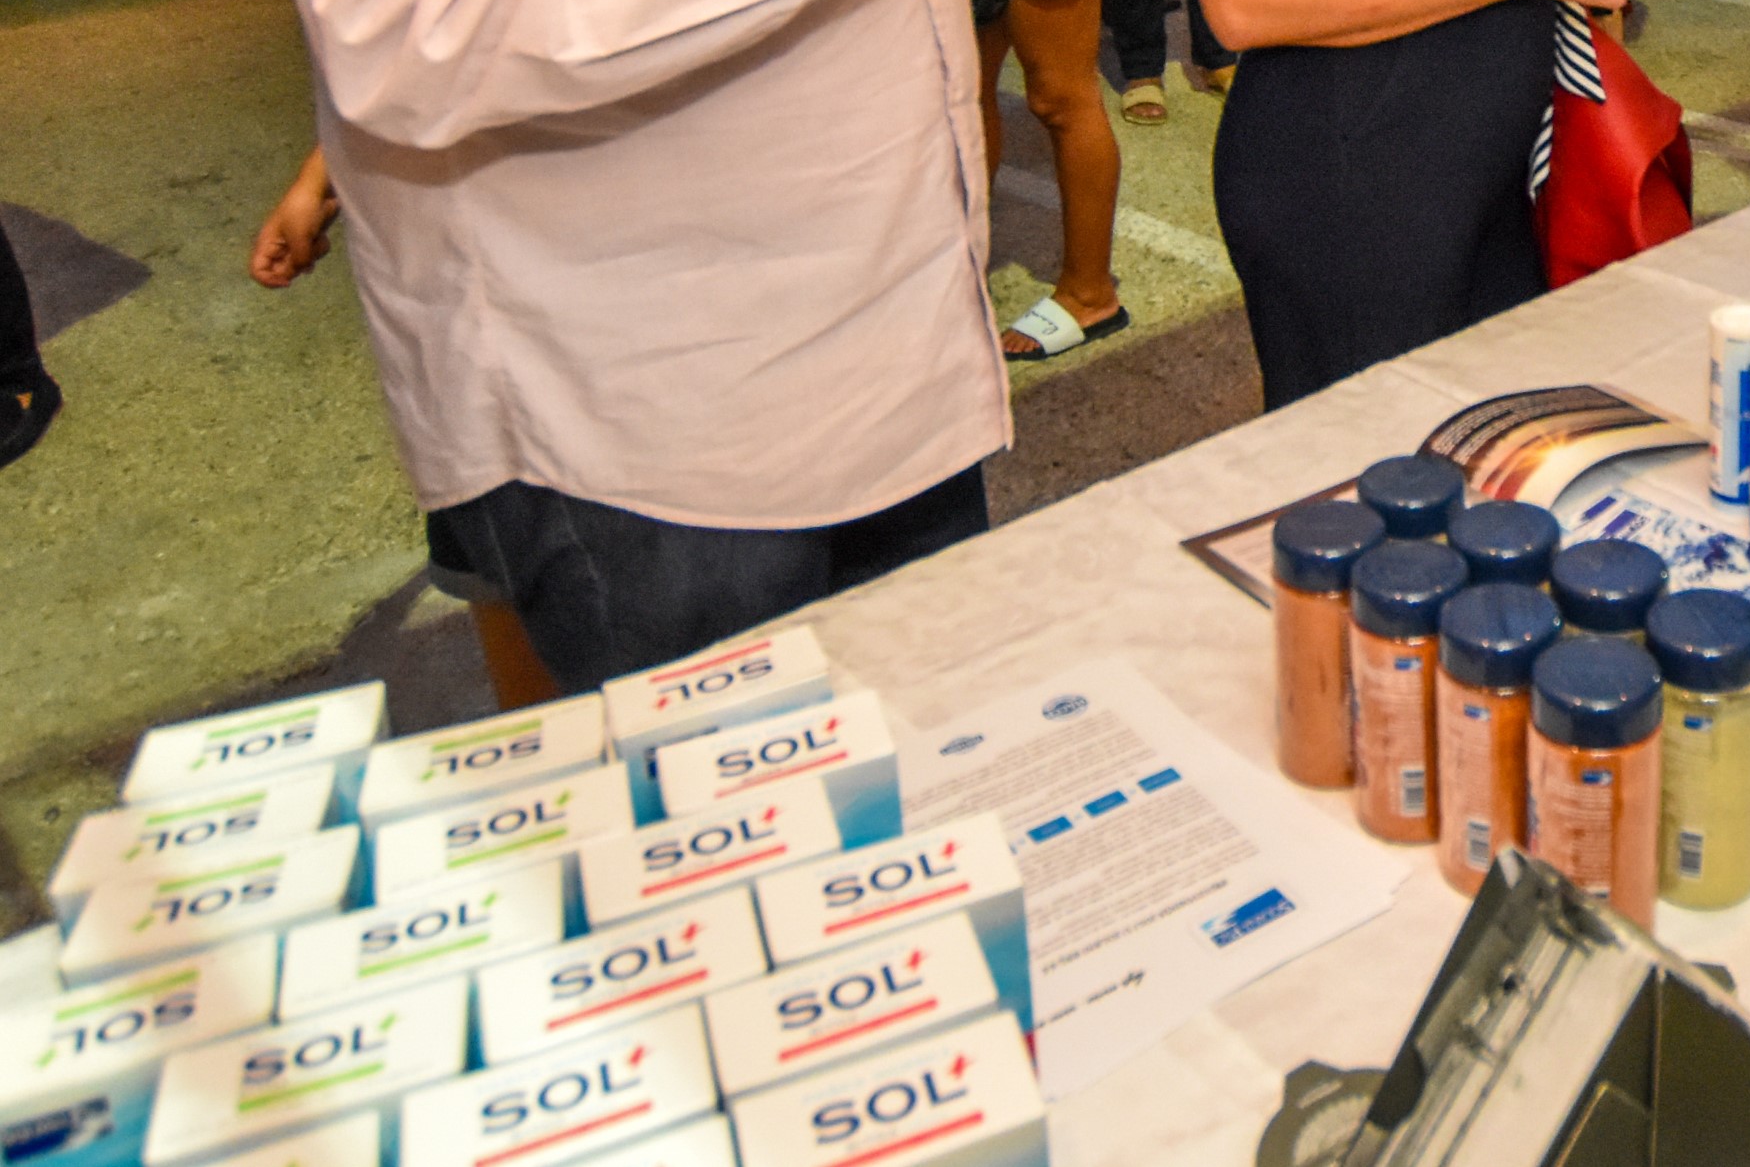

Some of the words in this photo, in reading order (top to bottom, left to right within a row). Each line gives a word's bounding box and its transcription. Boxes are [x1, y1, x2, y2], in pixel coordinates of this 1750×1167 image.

[657, 657, 773, 700] SOL
[207, 723, 315, 763] SOL
[430, 737, 543, 775] SOL
[716, 727, 837, 778] SOL
[138, 811, 259, 852] SOL
[446, 801, 567, 847] SOL
[642, 818, 775, 872] SOL
[151, 882, 277, 923] SOL
[822, 853, 955, 908] SOL
[359, 903, 486, 952] SOL
[550, 937, 696, 1001] SOL
[52, 993, 196, 1054] SOL
[777, 965, 922, 1030] SOL
[242, 1028, 388, 1086] SOL
[481, 1062, 641, 1134] SOL
[812, 1071, 968, 1145] SOL
